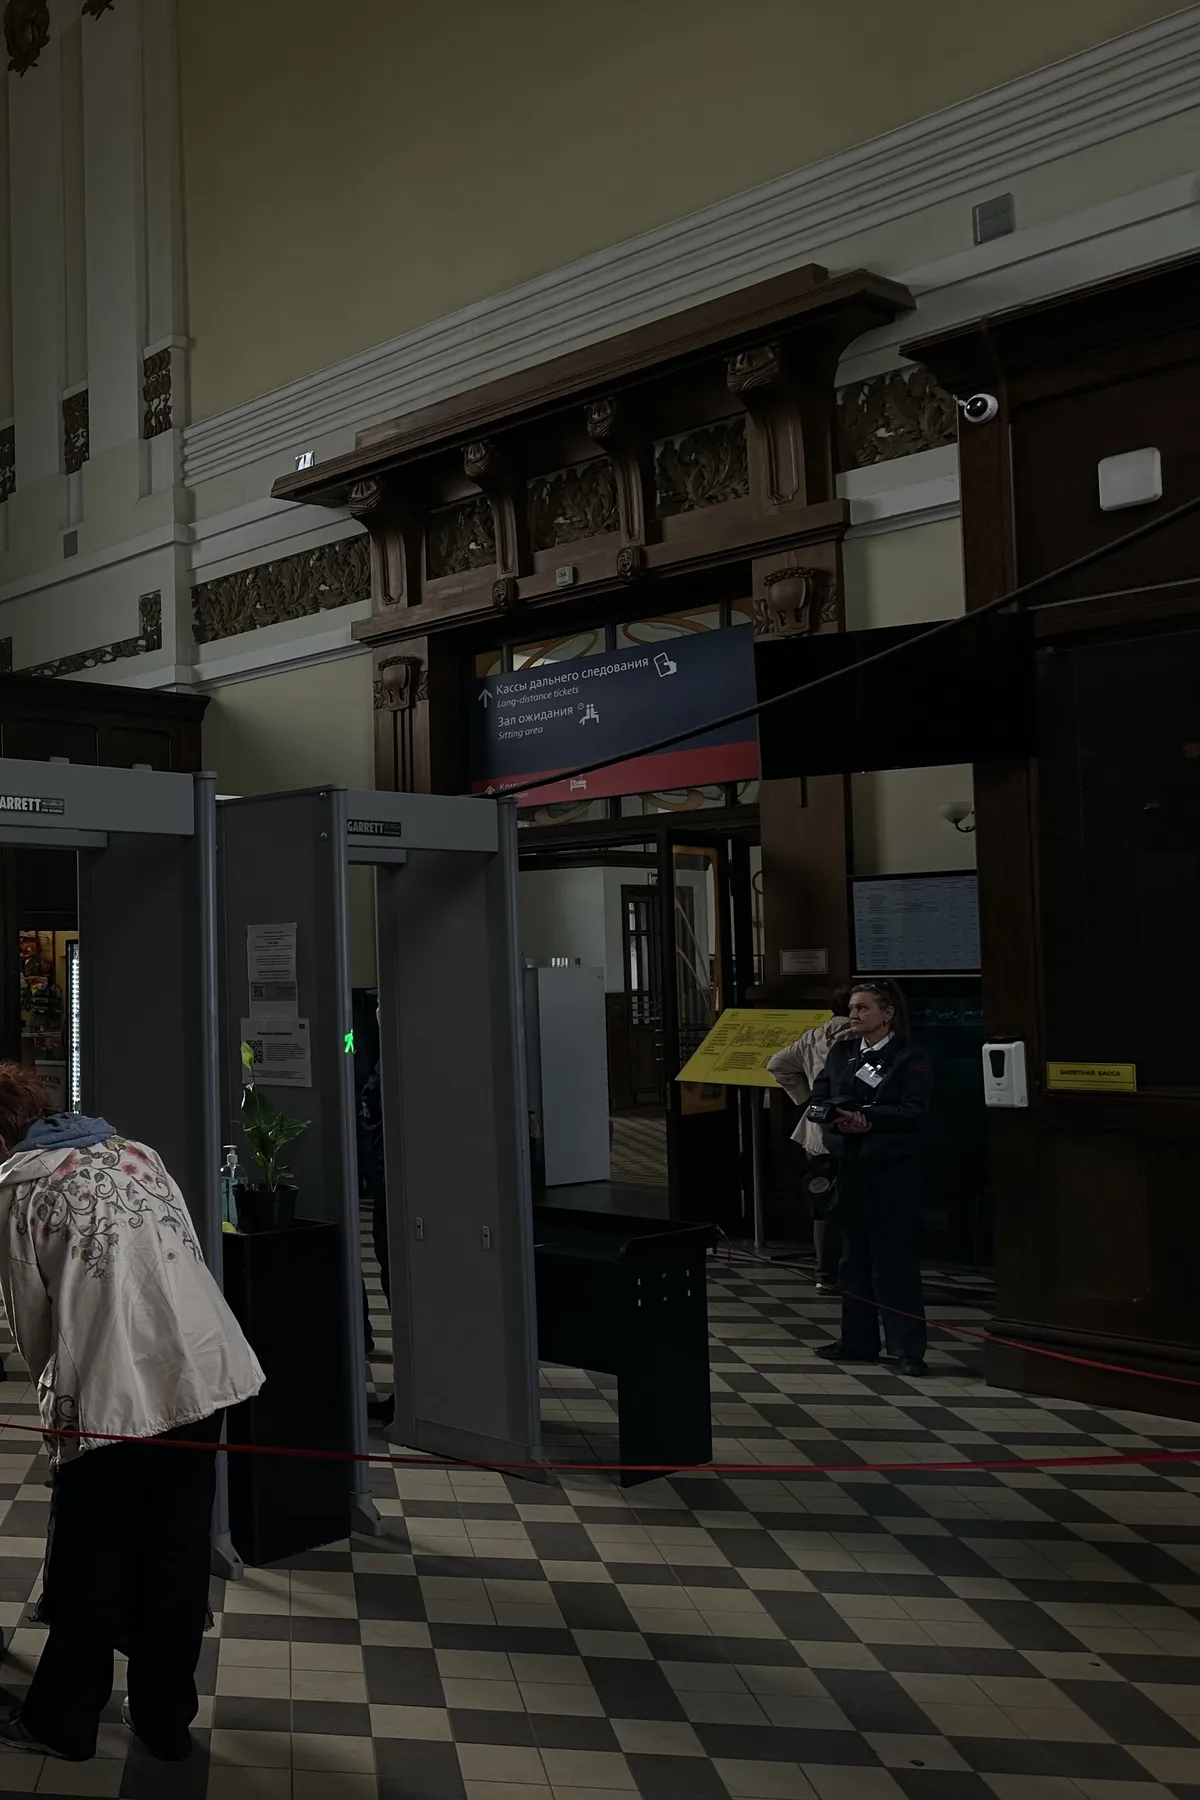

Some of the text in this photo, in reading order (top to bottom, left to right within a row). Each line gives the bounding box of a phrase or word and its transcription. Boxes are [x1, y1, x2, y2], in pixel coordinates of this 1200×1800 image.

[496, 657, 649, 696] Кассы дальнего следования
[497, 685, 579, 709] Long-distance tickets
[497, 705, 574, 728] Зал ожидания
[498, 726, 544, 740] Sitting area
[347, 820, 384, 834] GARRETT
